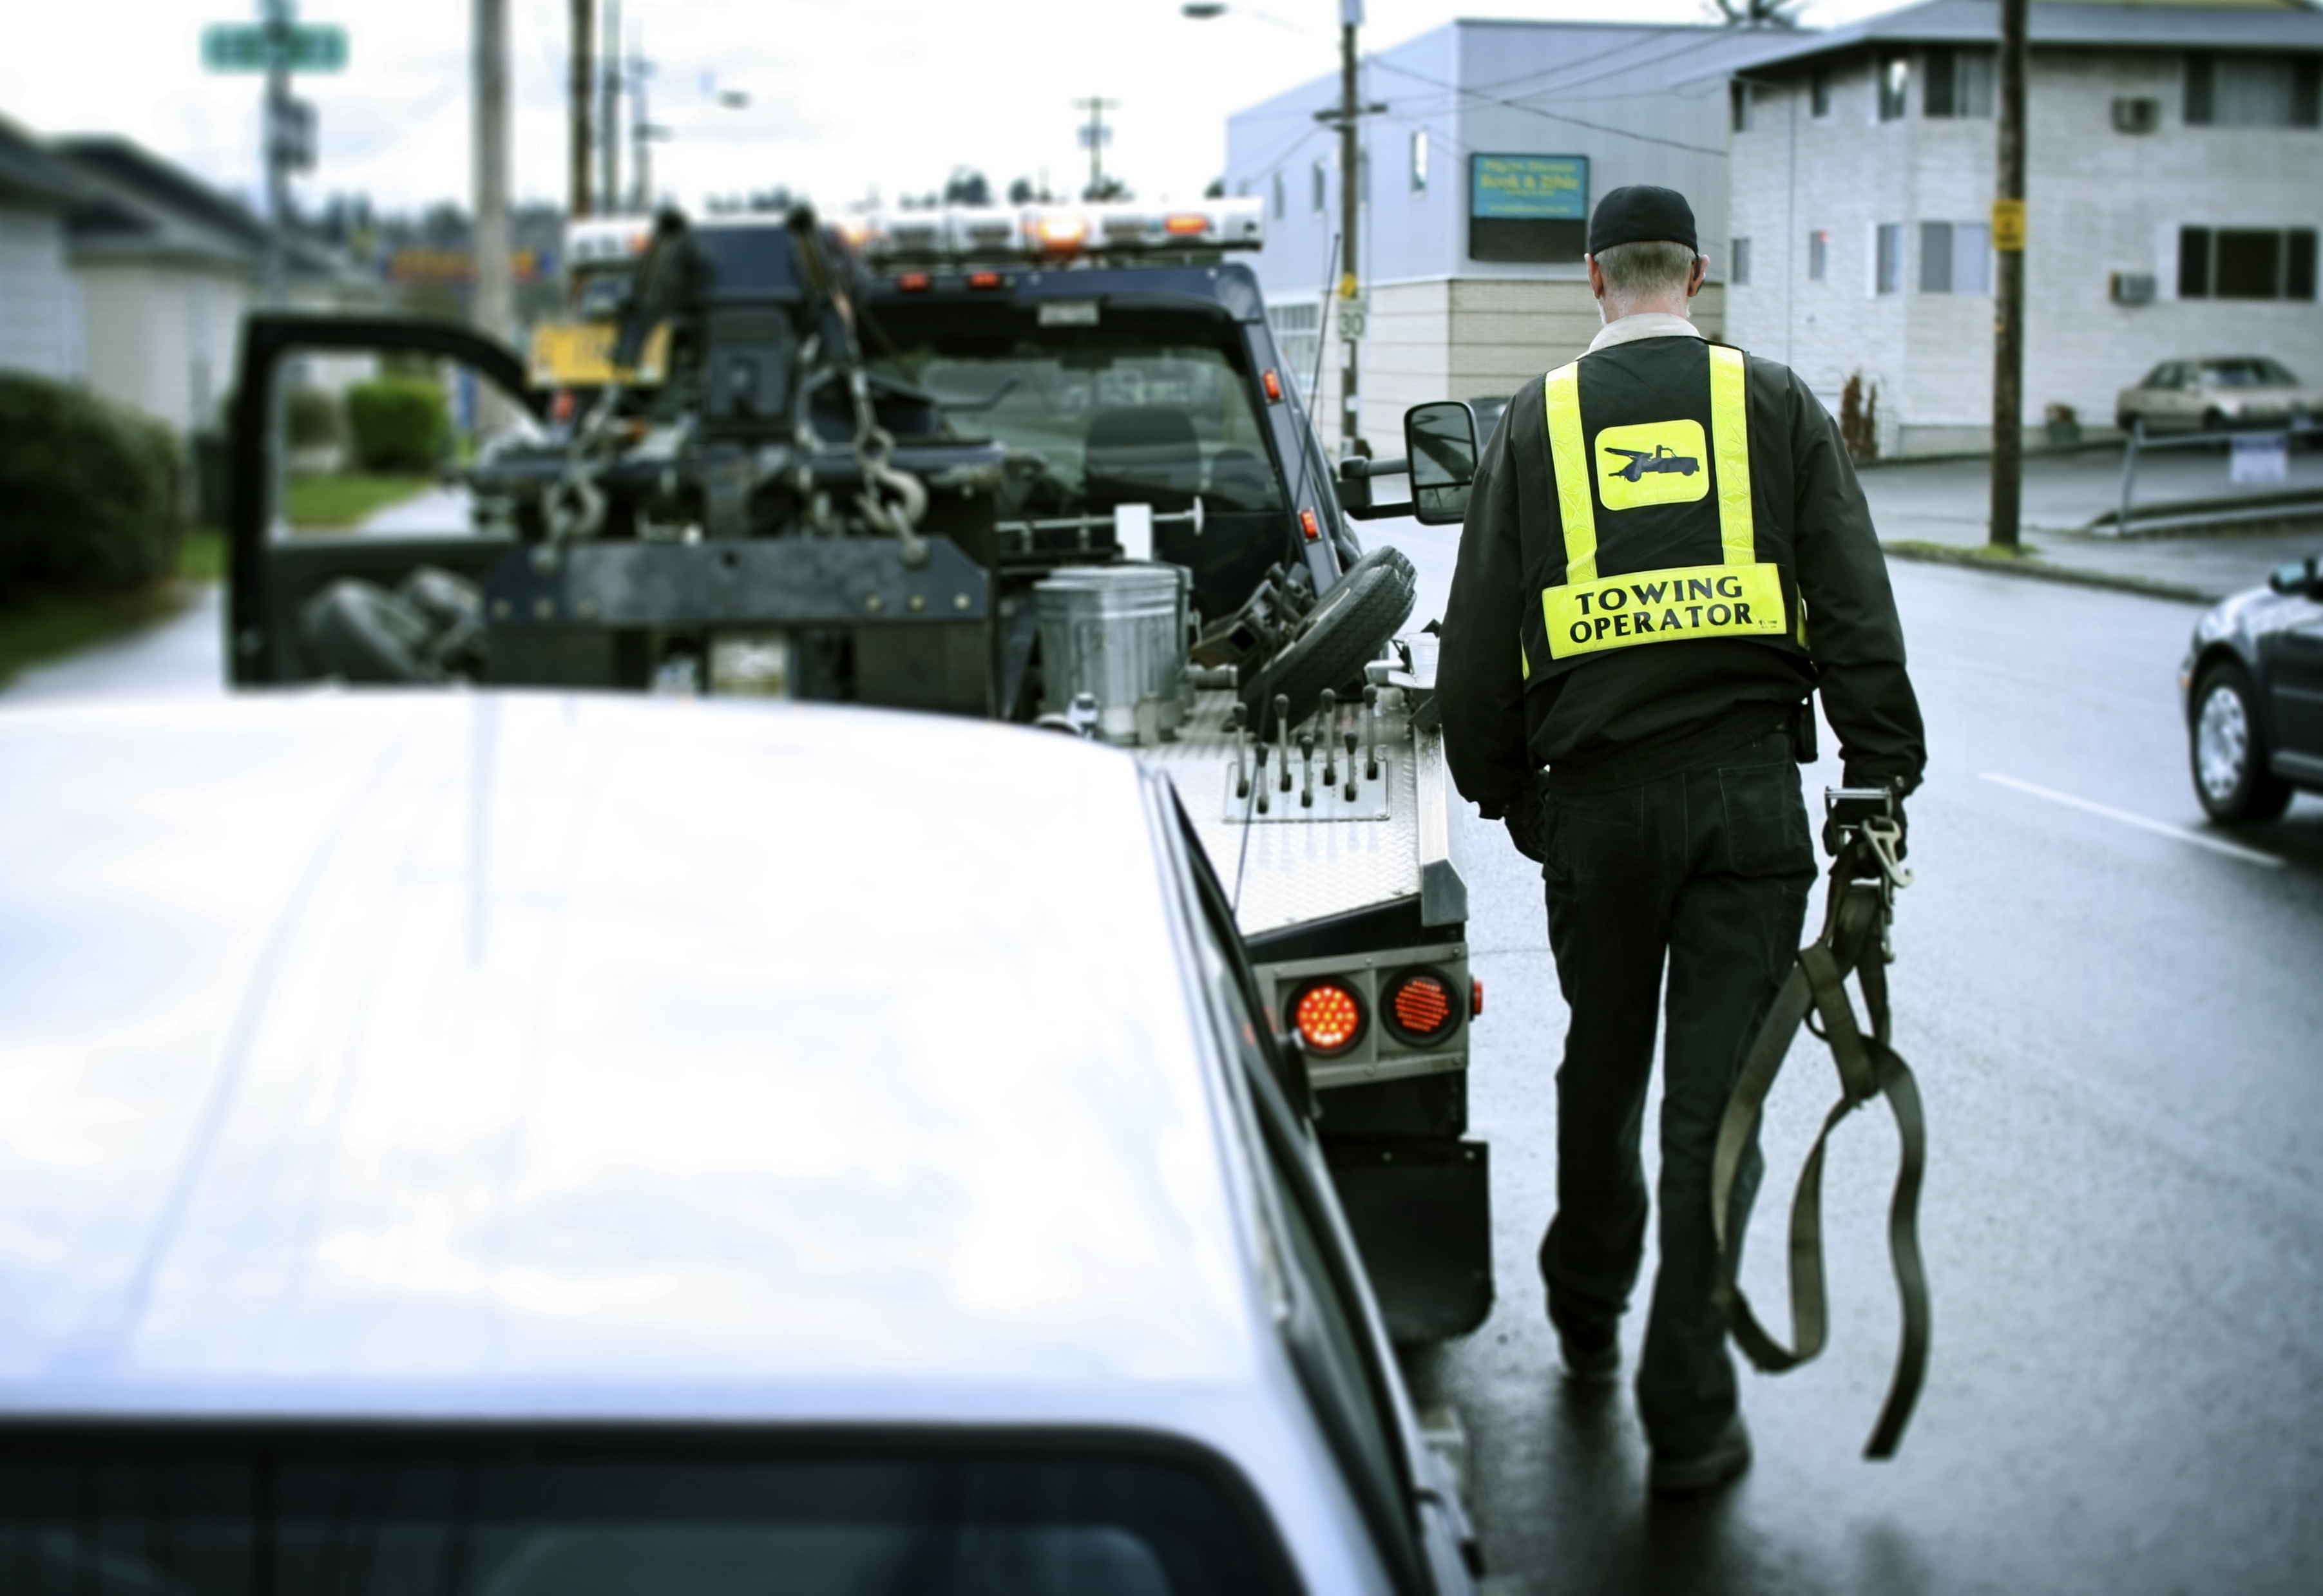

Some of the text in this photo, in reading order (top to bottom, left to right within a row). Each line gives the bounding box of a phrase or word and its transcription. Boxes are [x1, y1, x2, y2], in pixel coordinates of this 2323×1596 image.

[1338, 312, 1364, 336] 30
[1574, 576, 1743, 615] TOWING
[1569, 602, 1753, 644] OPERATOR
